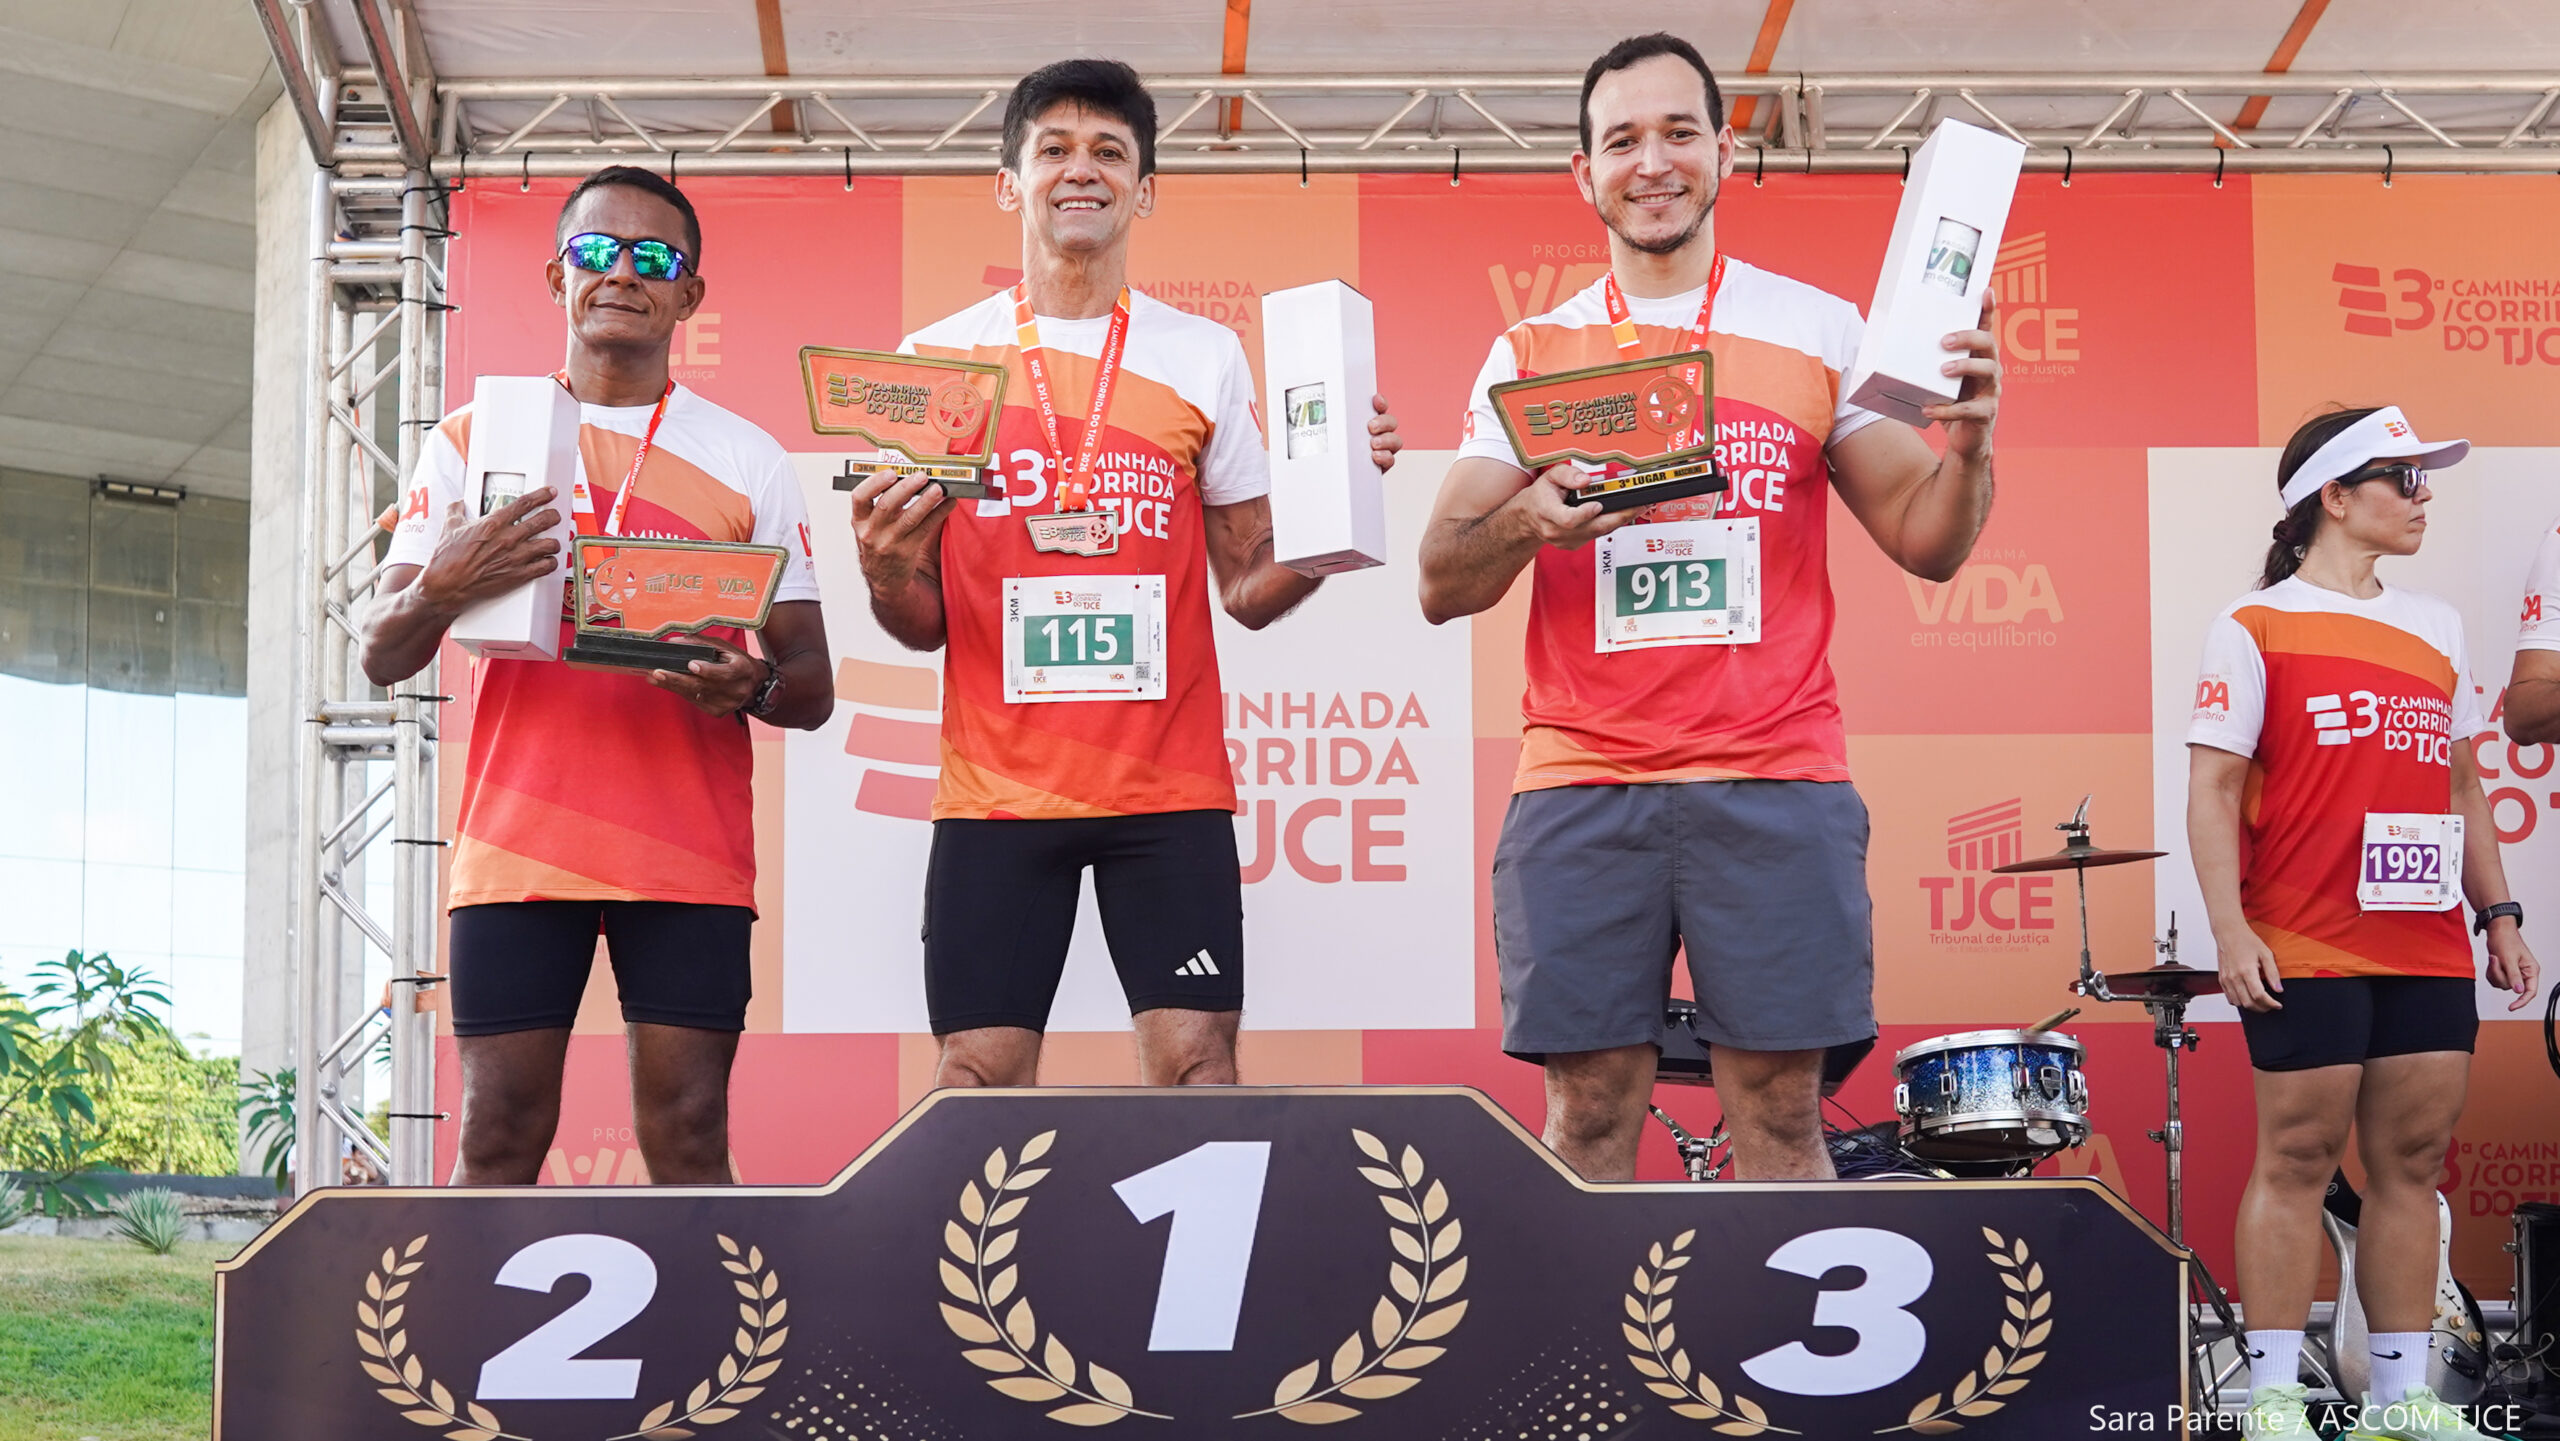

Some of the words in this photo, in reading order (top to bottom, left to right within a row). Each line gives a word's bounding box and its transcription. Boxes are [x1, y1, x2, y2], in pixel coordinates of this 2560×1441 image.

[1532, 244, 1611, 258] PROGRA
[1137, 281, 1256, 298] MINHADA
[2452, 278, 2560, 297] CAMINHA
[2443, 298, 2560, 322] /CORRI
[2443, 325, 2490, 351] DO
[2495, 327, 2560, 366] TJC
[1029, 359, 1043, 379] 2026
[2032, 363, 2076, 376] Justiça
[871, 382, 931, 396] CAMINHADA
[1572, 391, 1637, 410] CAMINHADA
[867, 401, 886, 414] DO
[885, 403, 927, 425] TJCE
[1090, 414, 1101, 429] DO
[1572, 419, 1593, 435] DO
[1593, 412, 1637, 436] TJCE
[1084, 428, 1097, 449] TJCE
[1062, 451, 1176, 480] CMINHADA
[1079, 452, 1092, 474] 2026
[1632, 472, 1666, 487] LUGAR
[1603, 549, 1612, 575] 3KM
[1675, 548, 1692, 556] TJCE
[1971, 549, 2027, 561] GRAMA
[666, 573, 703, 591] TJCE
[1631, 562, 1711, 611] 913
[1010, 597, 1019, 623] 3KM
[1083, 601, 1101, 610] TJCE
[1041, 617, 1119, 662] 115
[1911, 631, 1943, 648] em
[1947, 624, 2058, 654] equilíbrio
[1222, 691, 1430, 729] INHADA
[2384, 709, 2451, 735] /CORRID
[2384, 730, 2412, 751] DO
[1224, 736, 1420, 786] RRIDA
[1234, 797, 1407, 884] JCE
[2368, 845, 2439, 881] 1992
[1919, 876, 2055, 932] TJCE
[1929, 933, 1983, 945] Tribunal
[1985, 933, 2003, 944] de
[2006, 932, 2050, 947] Justiça
[2479, 1142, 2558, 1160] CAMIN
[2470, 1189, 2516, 1217] DO
[1111, 1140, 1271, 1352] 1
[475, 1233, 658, 1400] 2
[1739, 1226, 1934, 1396] 3
